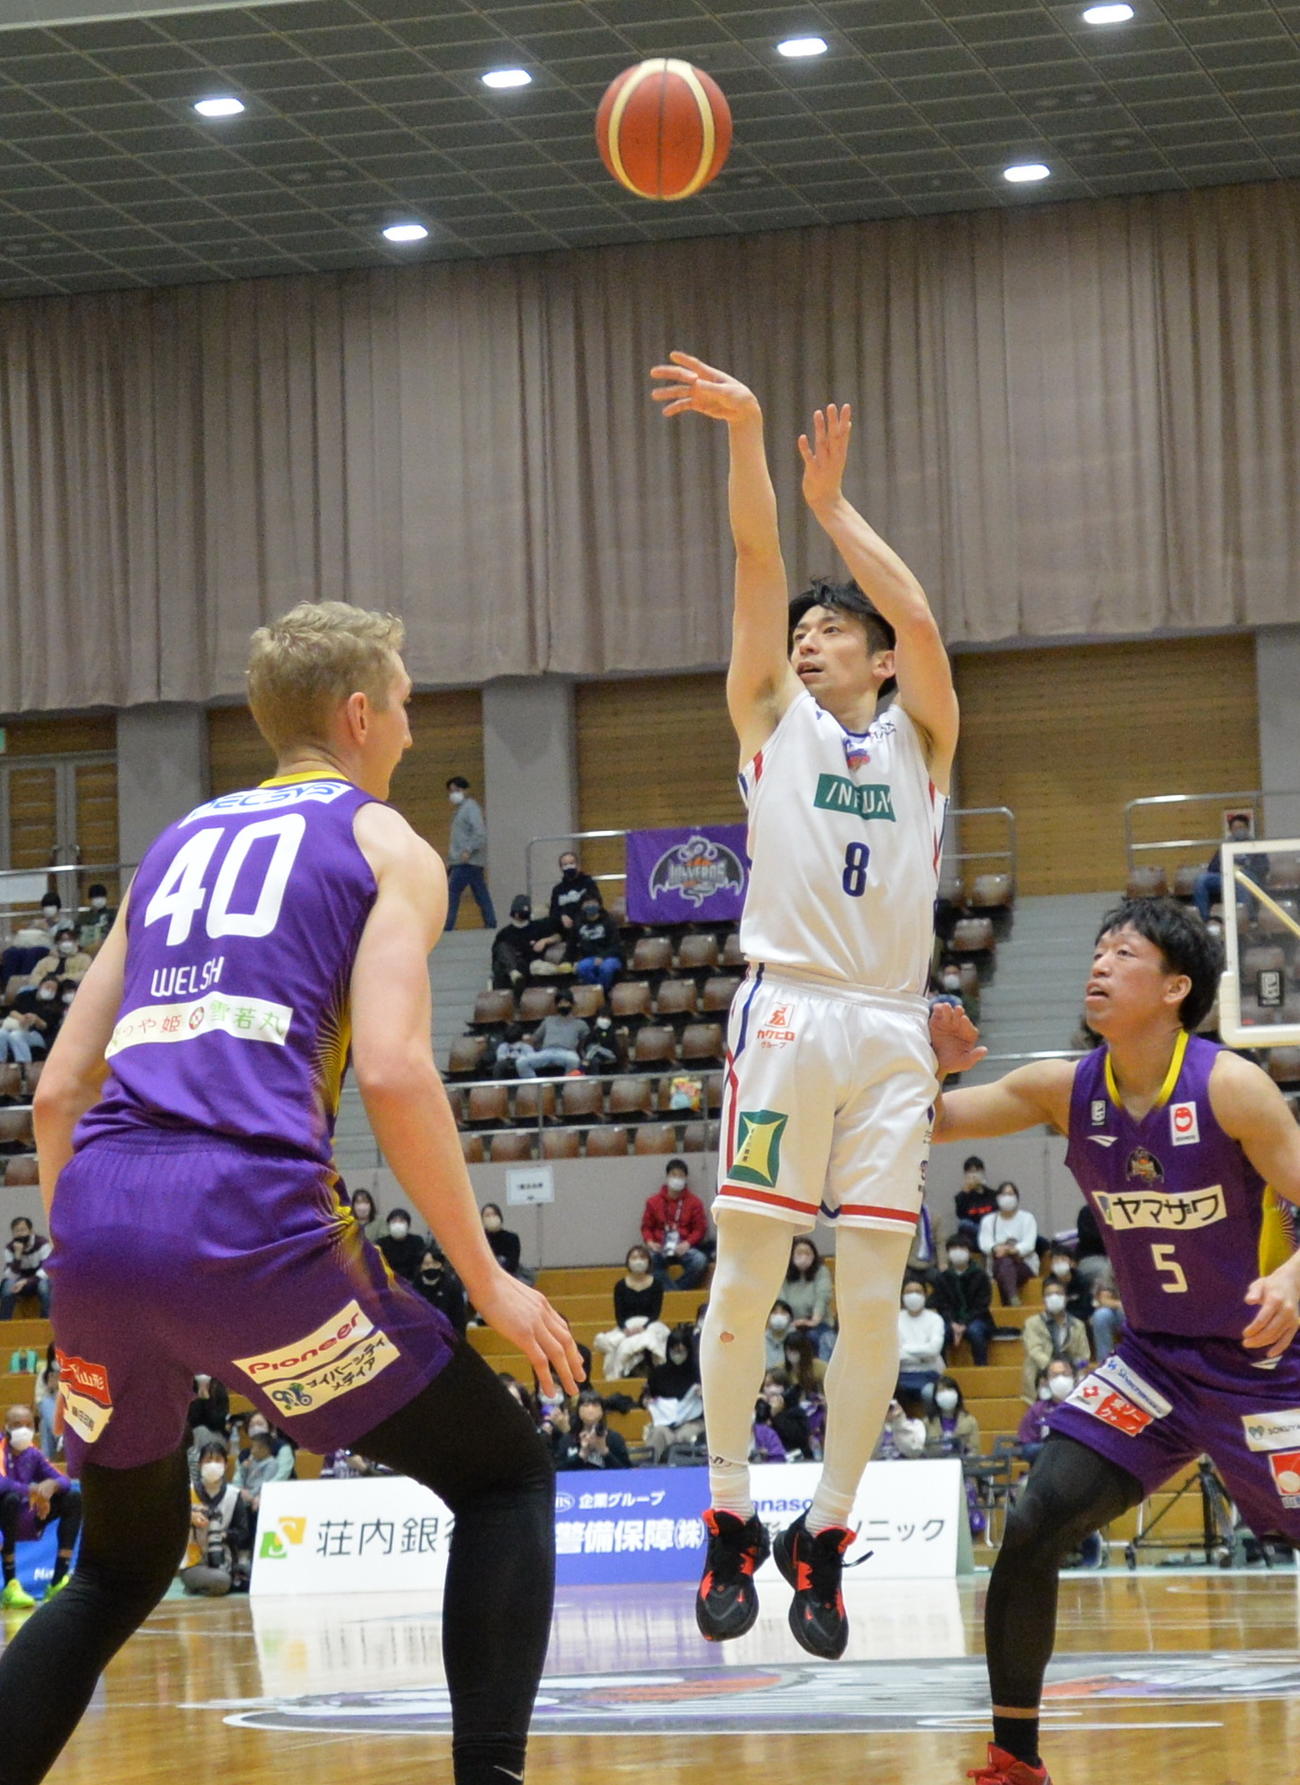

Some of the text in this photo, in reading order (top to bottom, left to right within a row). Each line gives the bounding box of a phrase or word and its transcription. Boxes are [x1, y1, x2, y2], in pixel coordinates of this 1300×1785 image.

[144, 813, 306, 946] 40
[842, 841, 870, 897] 8
[150, 956, 225, 998] WELSH
[1112, 1193, 1219, 1226] ヤマザワ
[1150, 1243, 1189, 1293] 5
[248, 1311, 360, 1375] Pioneer
